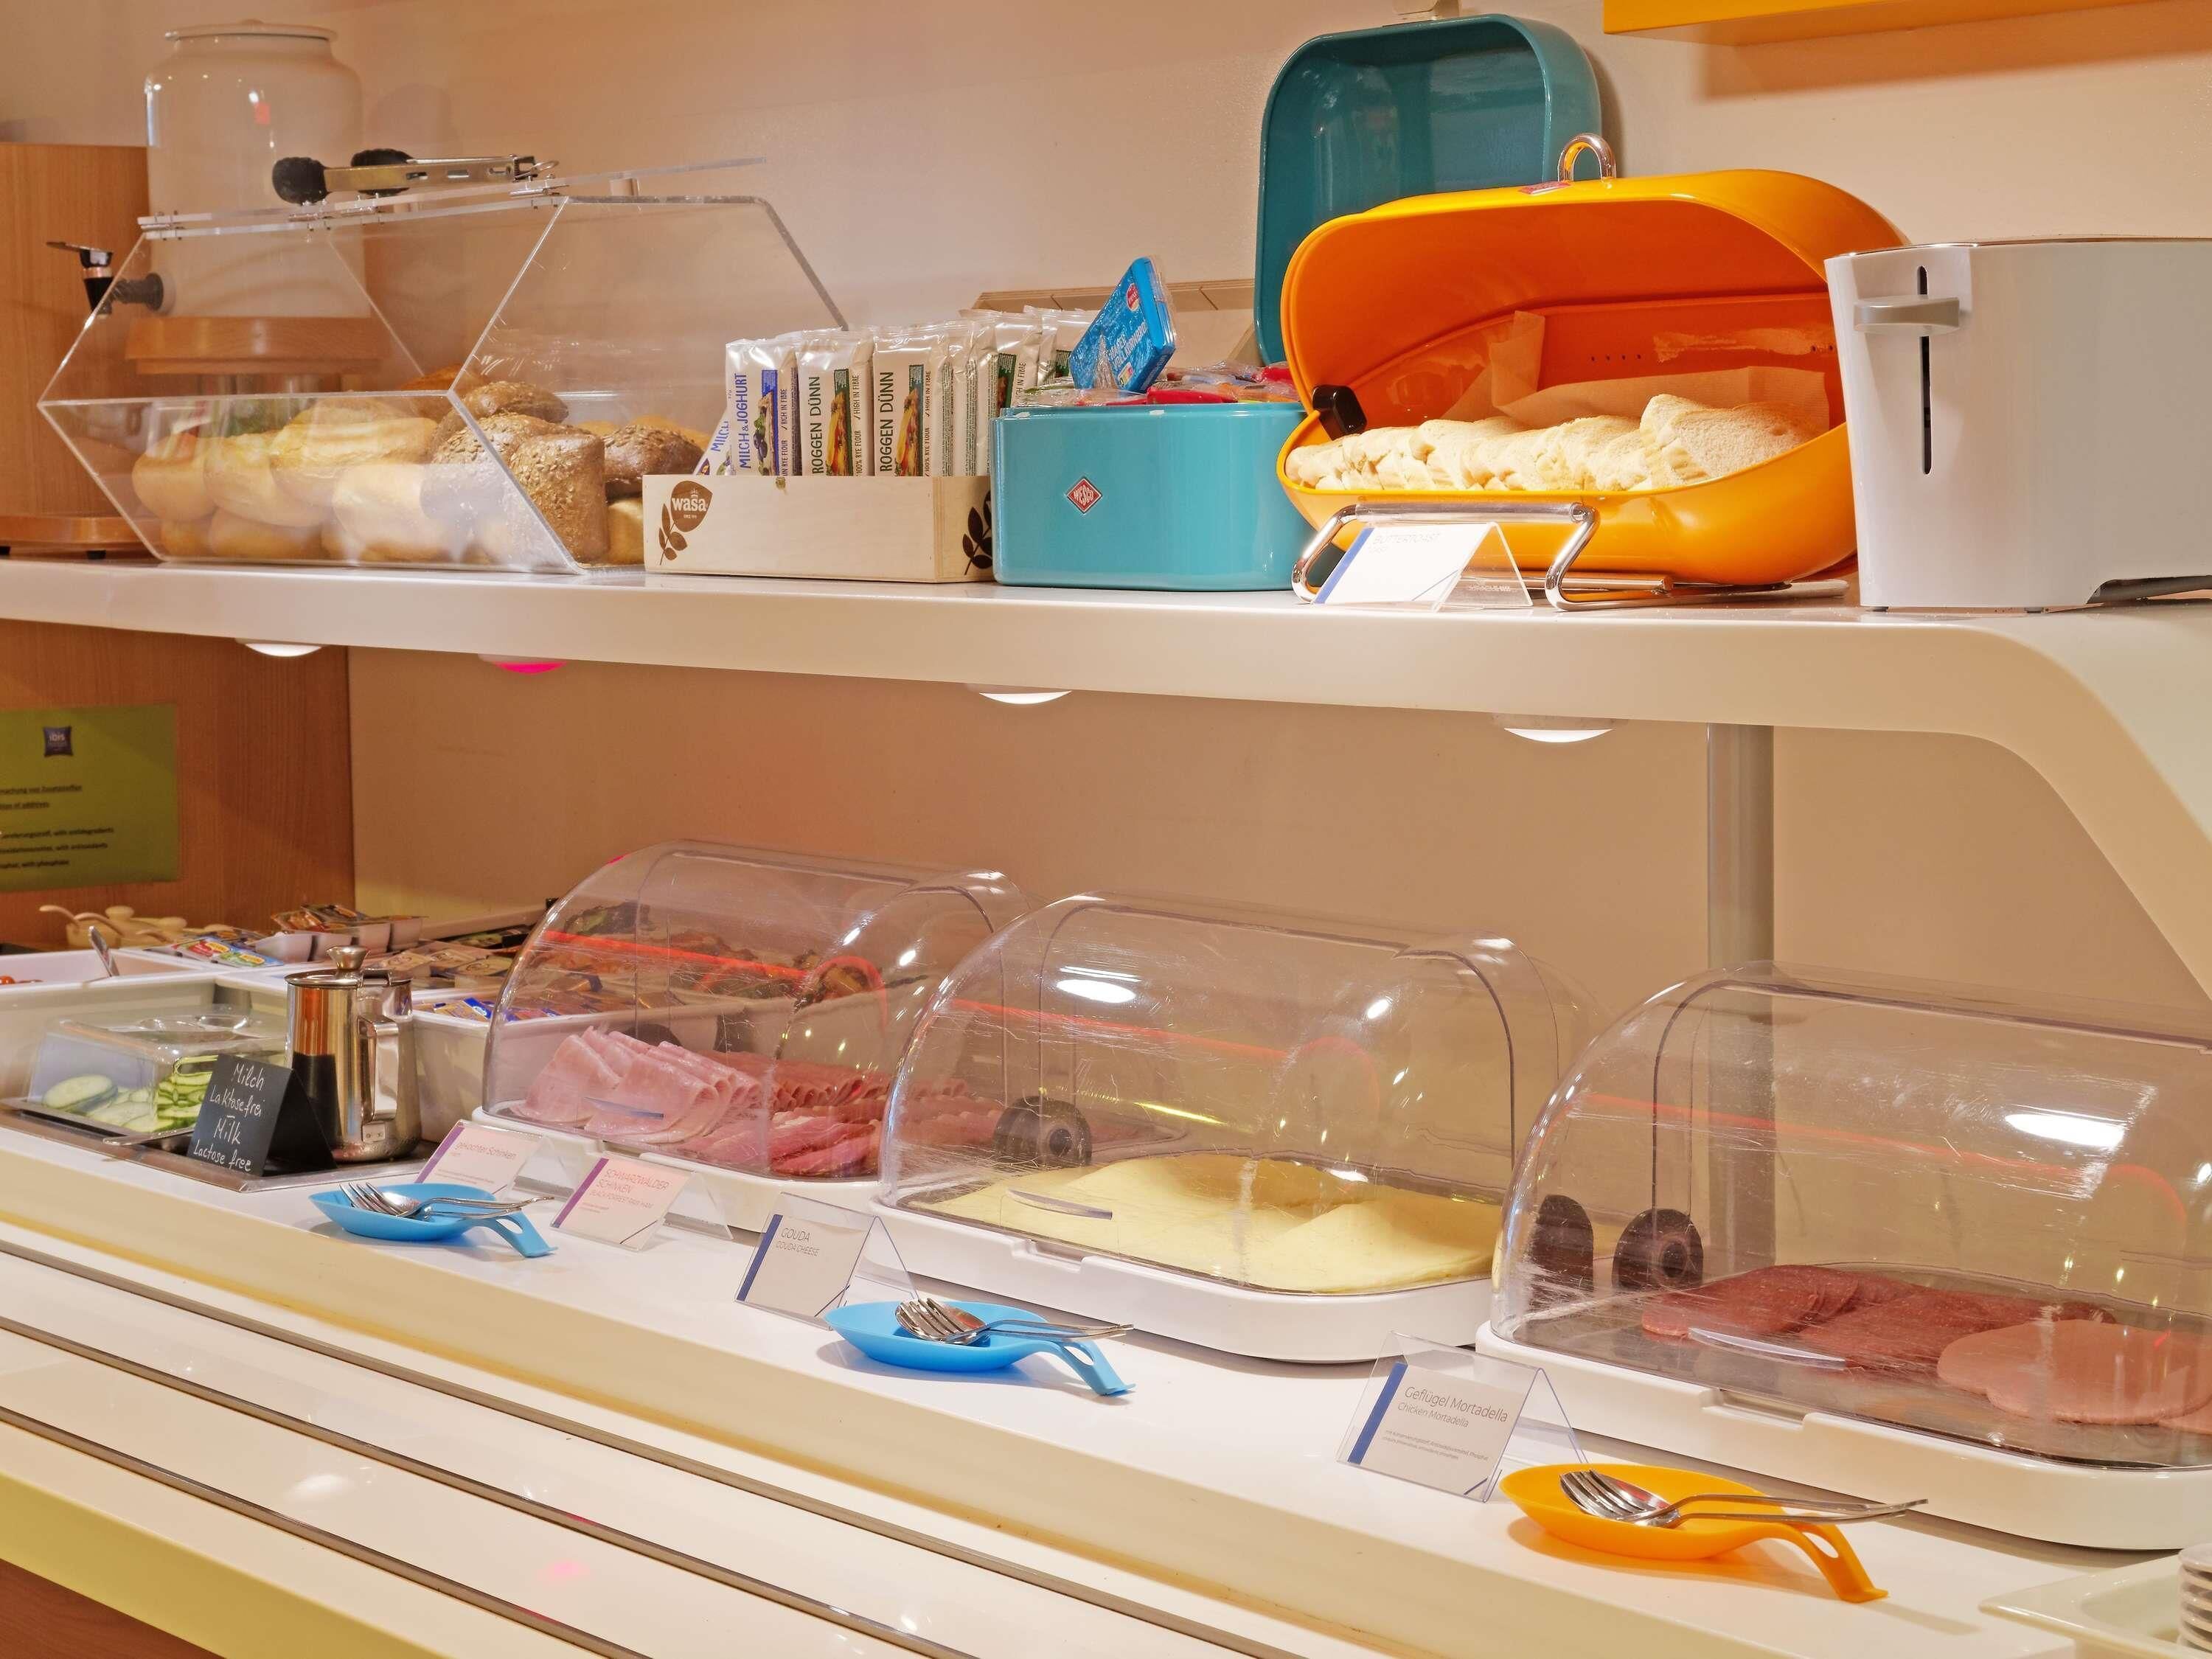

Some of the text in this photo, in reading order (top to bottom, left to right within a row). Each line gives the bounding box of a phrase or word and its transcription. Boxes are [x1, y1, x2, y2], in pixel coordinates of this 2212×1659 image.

[1018, 362, 1026, 378] FIBRE
[734, 373, 748, 424] JOGHURT
[808, 376, 824, 474] ROGGEN DÜNN
[878, 372, 894, 472] ROGGEN DÜNN
[738, 433, 751, 469] MILCH
[854, 430, 862, 446] FLOUR
[672, 498, 706, 512] wasa
[1073, 484, 1094, 505] WESCO
[49, 732, 66, 741] ibis
[233, 1062, 265, 1091] Milch
[213, 1118, 241, 1145] Milk
[193, 1139, 251, 1172] Lactose free
[781, 1227, 811, 1242] GOUDA
[776, 1241, 821, 1257] GOUDA CHEESE
[1397, 1402, 1470, 1428] Chicken Mortadella
[1405, 1386, 1509, 1422] Geflügel Mortadella
